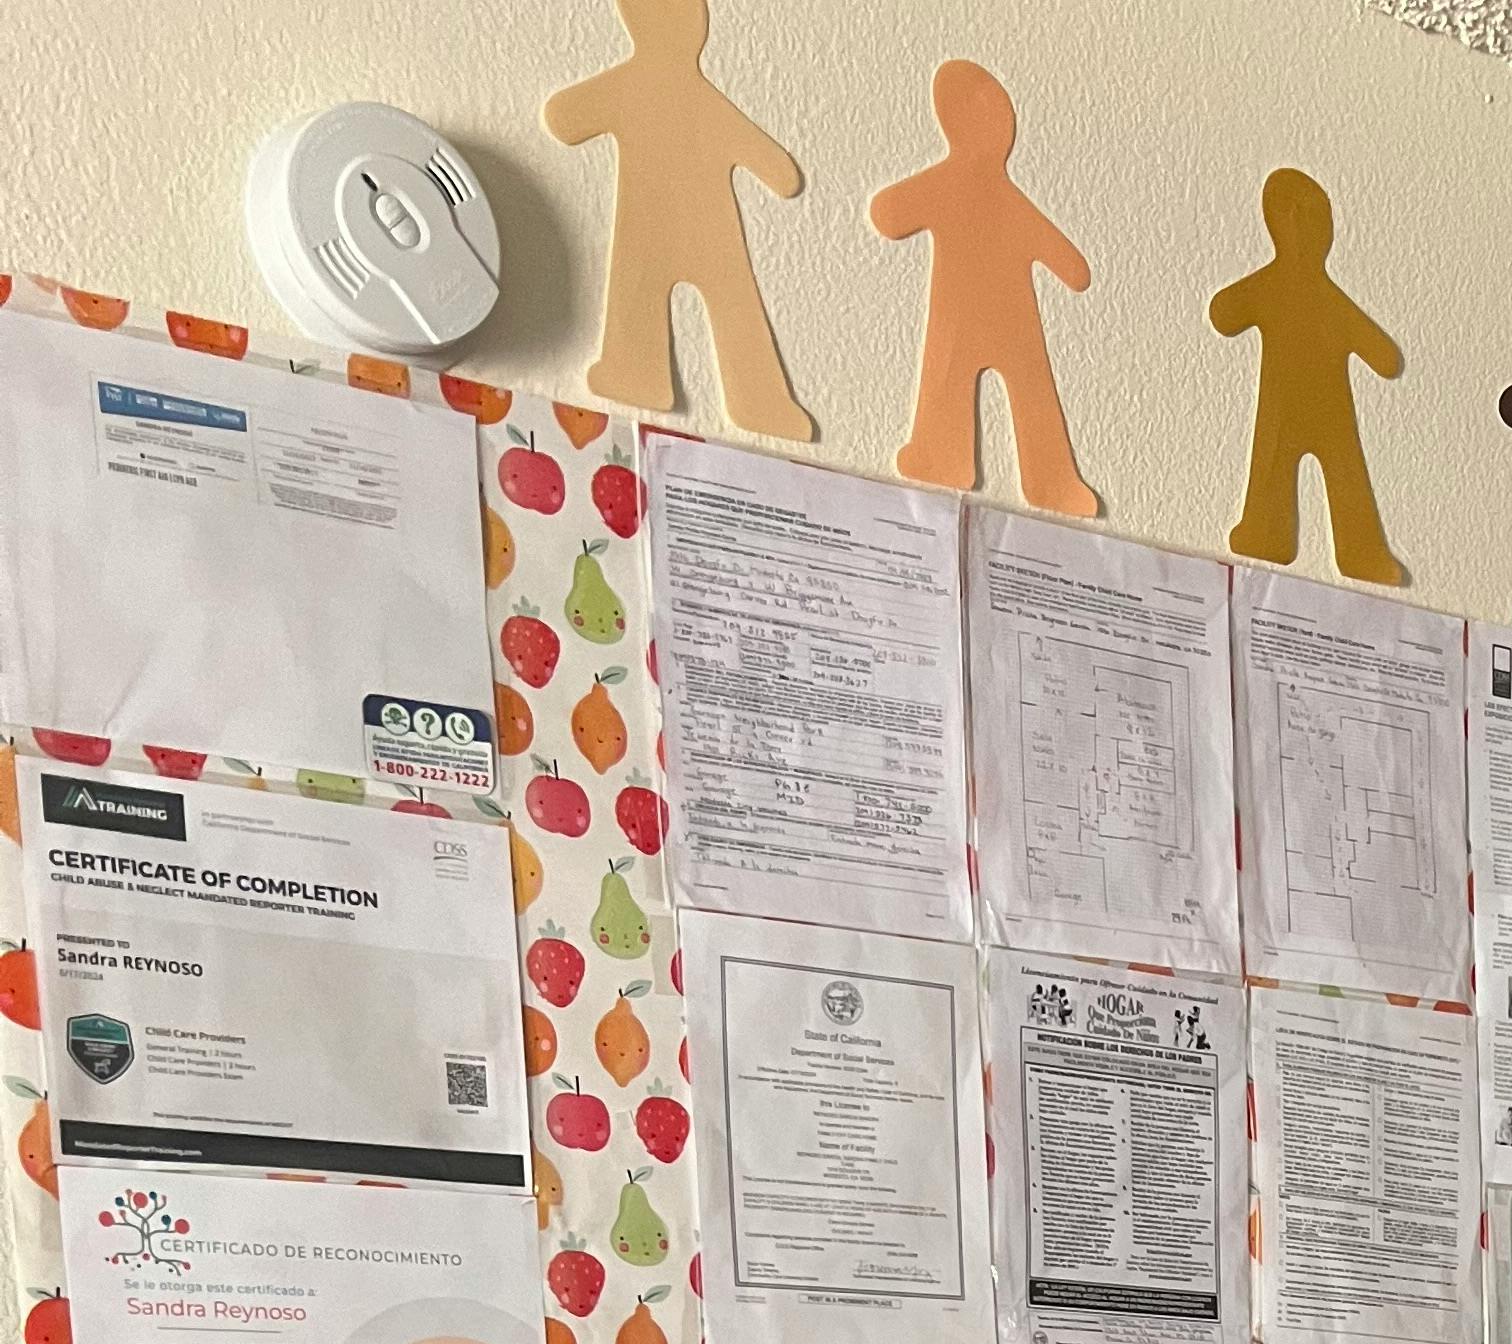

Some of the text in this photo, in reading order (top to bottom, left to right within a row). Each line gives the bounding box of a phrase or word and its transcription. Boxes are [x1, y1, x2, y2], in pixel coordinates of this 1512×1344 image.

[374, 760, 489, 788] 1-800-222-1222
[97, 800, 168, 821] TRAINING
[49, 849, 378, 909] CERTIFICATE OF COMPLETION
[51, 872, 85, 885] CHILD
[88, 877, 125, 891] ABUSE
[136, 884, 185, 898] NEGLECT
[187, 891, 248, 907] MANDATED
[249, 899, 304, 914] REPORTER
[307, 906, 356, 921] TRAINING
[57, 948, 203, 977] Sandra REYNOSO
[1097, 993, 1145, 1017] HOGAR
[160, 1238, 463, 1267] CERTIFICADO DE RECONOCIMIENTO
[124, 1279, 140, 1290] Se
[144, 1280, 155, 1290] le
[159, 1283, 203, 1295] otorga
[206, 1284, 234, 1294] este
[237, 1284, 305, 1297] certificado
[127, 1297, 307, 1324] Sandra Reynoso
